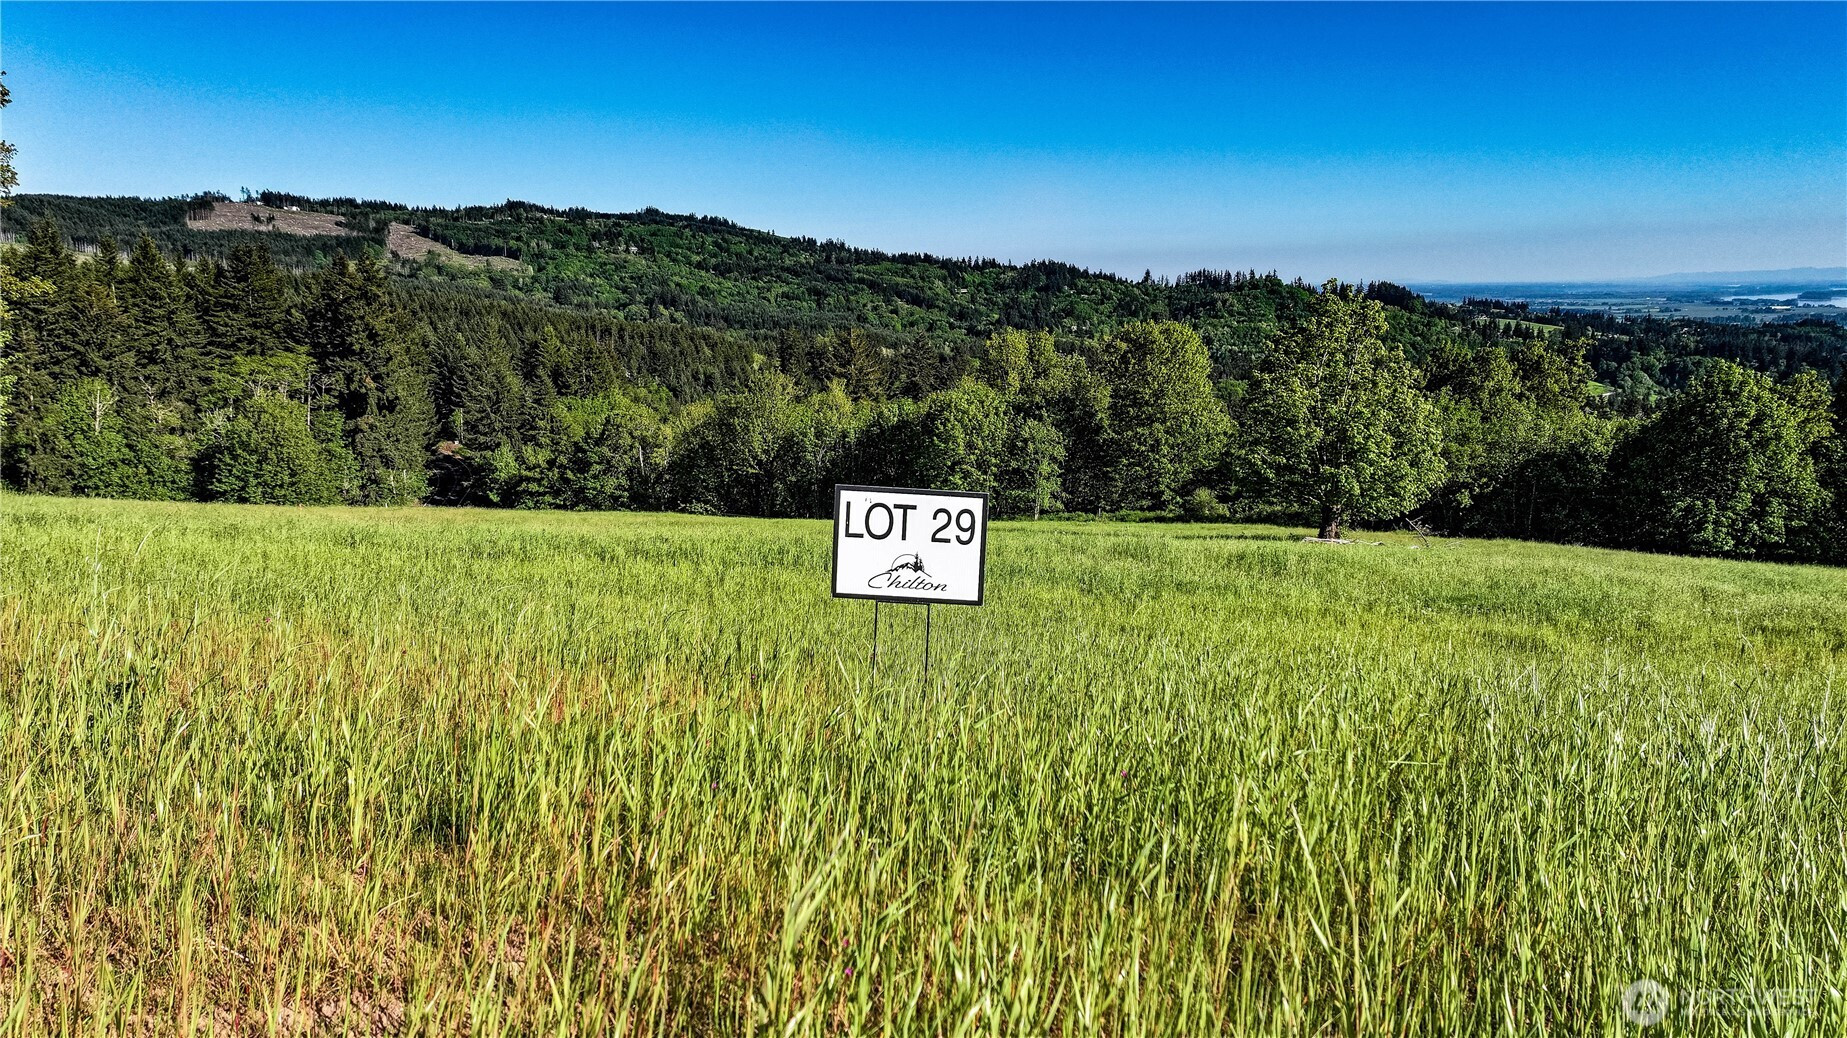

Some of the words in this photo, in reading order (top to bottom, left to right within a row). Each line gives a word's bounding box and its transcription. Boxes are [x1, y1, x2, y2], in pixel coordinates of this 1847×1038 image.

[845, 501, 917, 541] LOT
[931, 508, 976, 545] 29
[867, 572, 948, 592] Chilton
